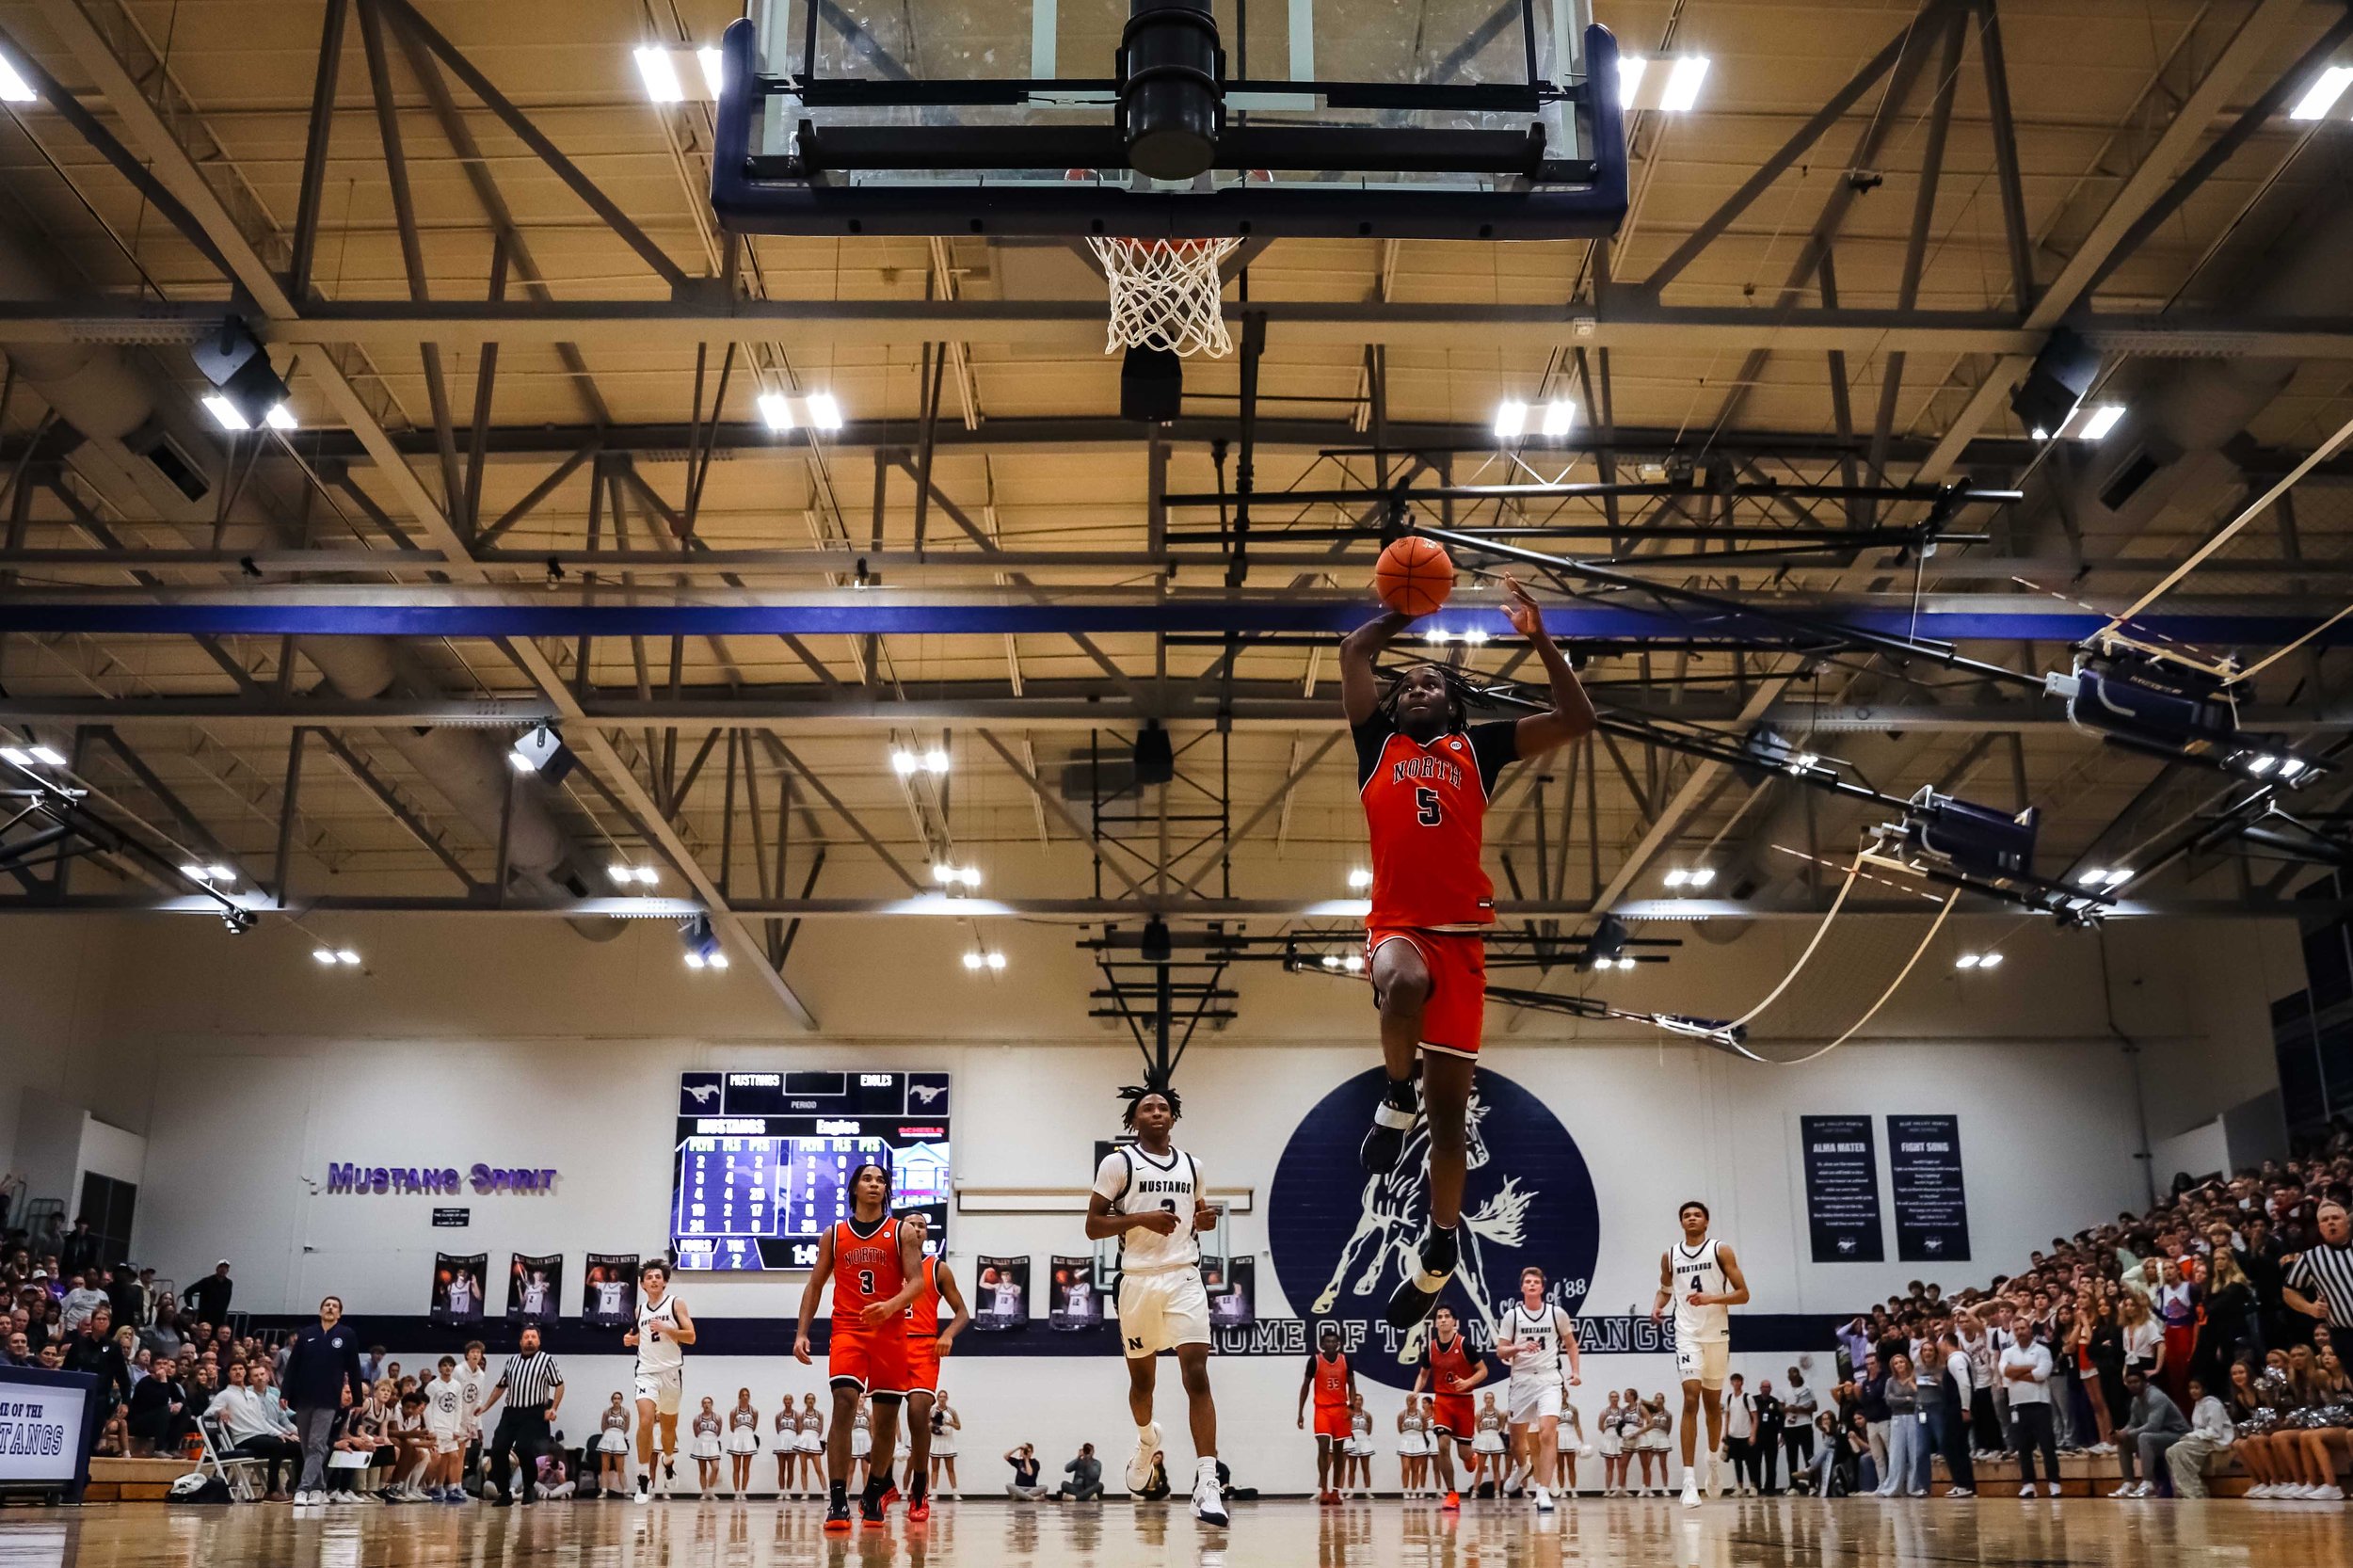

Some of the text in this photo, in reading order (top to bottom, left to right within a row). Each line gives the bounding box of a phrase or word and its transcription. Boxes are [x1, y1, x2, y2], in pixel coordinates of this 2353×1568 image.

[1393, 756, 1462, 790] NORTH
[1416, 787, 1442, 826] 5
[729, 1075, 779, 1086] MUSTANGS
[860, 1075, 892, 1086] EAGLES
[696, 1119, 765, 1134] MUSTANGS
[816, 1119, 859, 1136] Eagles
[1813, 1143, 1865, 1153] ALMA MATER
[1901, 1142, 1949, 1152] FIGHT SONG
[696, 1155, 763, 1168] 2 2 2
[807, 1155, 816, 1169] 2
[328, 1162, 557, 1192] MUSTANG SPIRIT
[696, 1171, 705, 1184] 3
[725, 1171, 734, 1184] 4
[807, 1171, 846, 1185] 3 1
[694, 1187, 703, 1200] 4
[724, 1187, 733, 1200] 4
[806, 1187, 845, 1201] 4 2
[1139, 1181, 1191, 1193] MUSTANGS
[724, 1203, 732, 1216] 2
[724, 1219, 731, 1232] 1
[731, 1253, 742, 1268] 2
[844, 1247, 887, 1269] NORTH
[1676, 1262, 1712, 1274] MUSTANGS
[858, 1270, 875, 1295] 3
[1690, 1274, 1703, 1293] 4
[1546, 1282, 1562, 1306] of
[1562, 1278, 1586, 1299] '88
[651, 1329, 661, 1343] 2
[1128, 1337, 1144, 1350] N
[1682, 1354, 1690, 1364] N
[1327, 1377, 1340, 1391] 35
[12, 1403, 24, 1417] OF
[26, 1403, 43, 1418] THE
